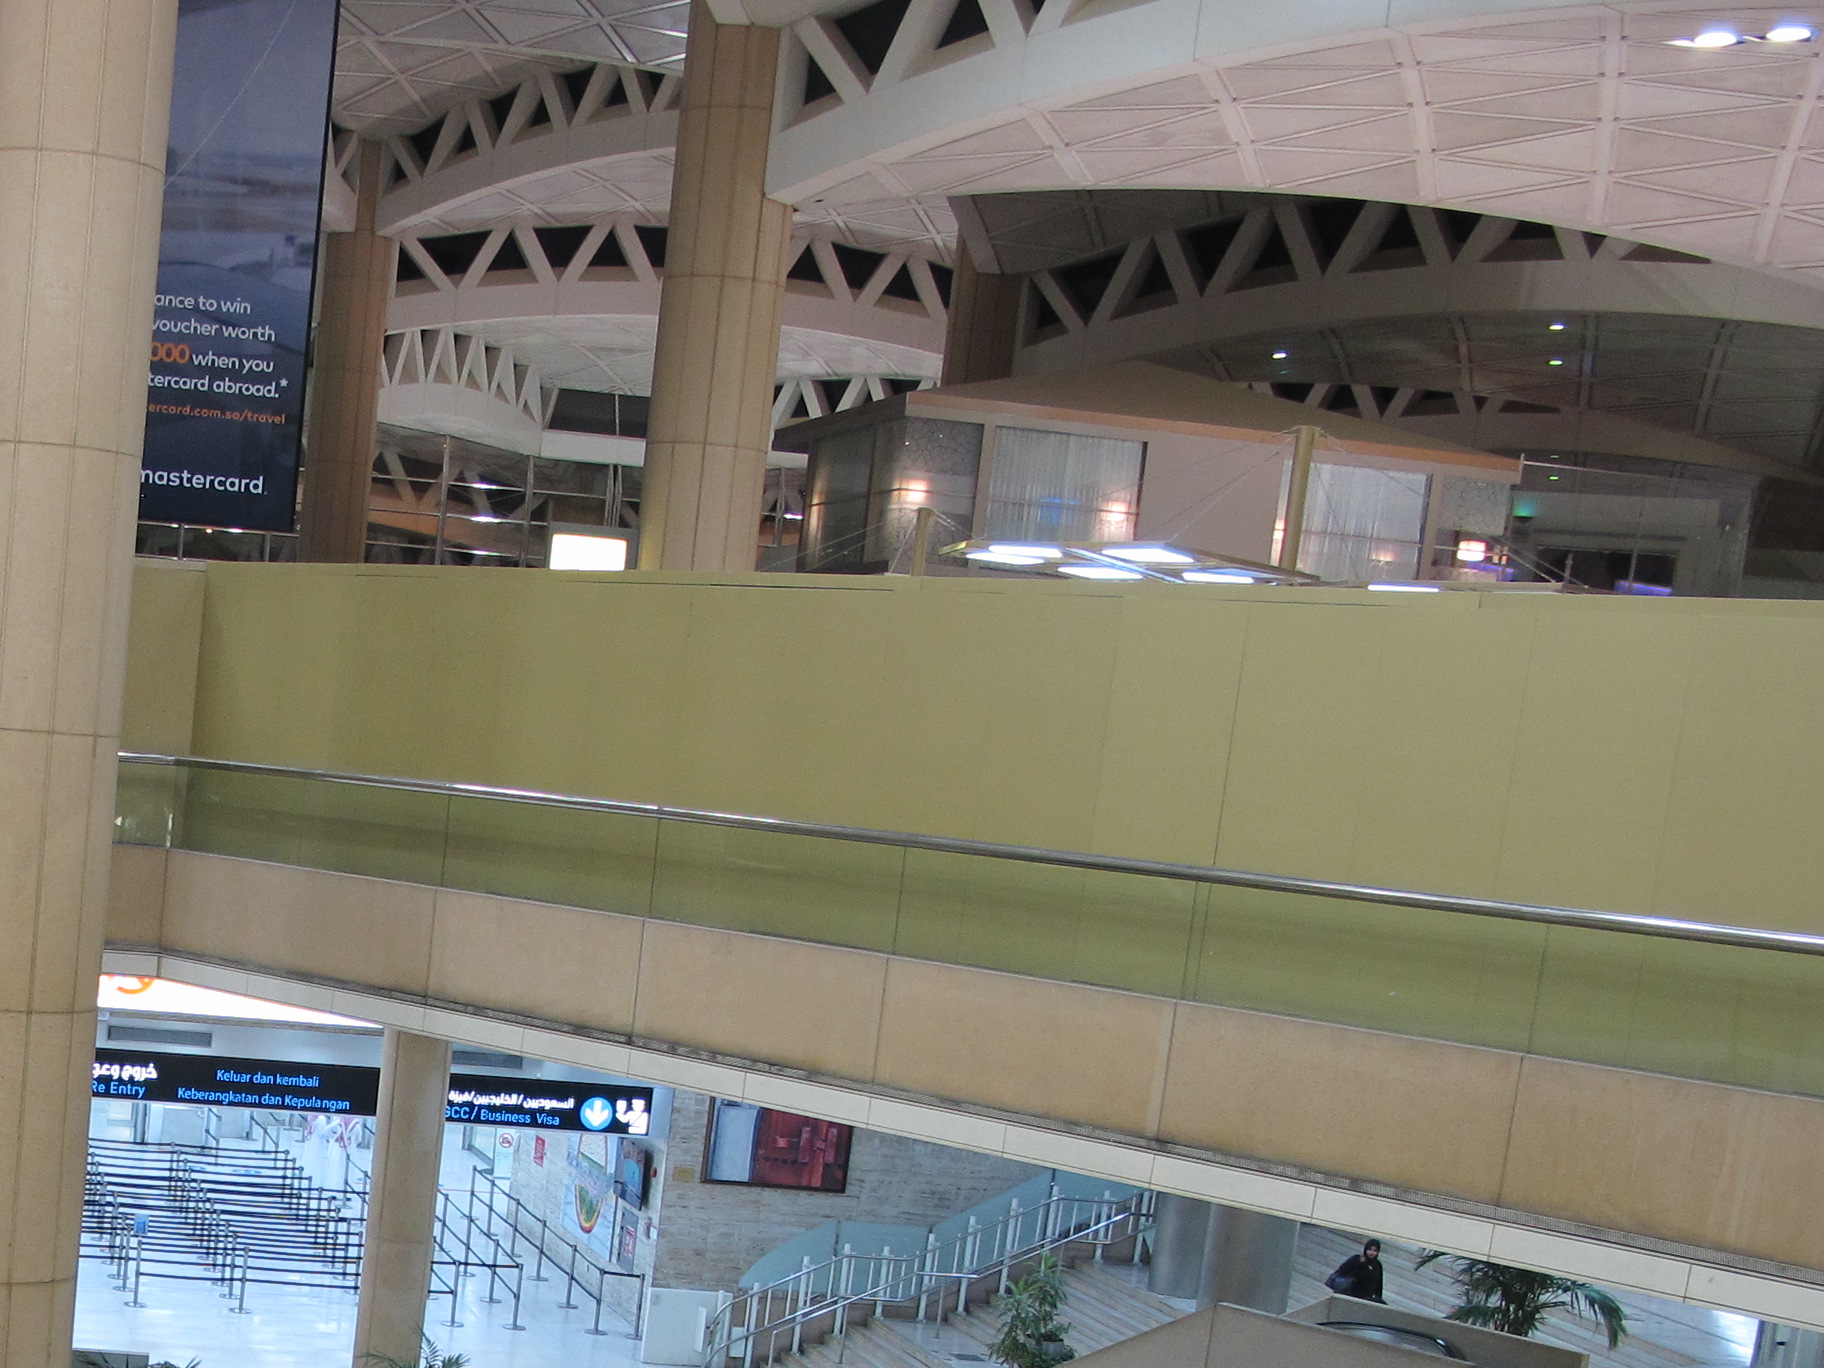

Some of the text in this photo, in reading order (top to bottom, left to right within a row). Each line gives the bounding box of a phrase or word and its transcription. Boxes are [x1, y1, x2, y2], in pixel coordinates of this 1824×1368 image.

[198, 296, 217, 312] to
[220, 298, 251, 315] win
[222, 325, 276, 342] worth
[192, 351, 239, 369] when
[242, 358, 274, 374] you
[216, 1069, 320, 1088] Keluar dan kembali
[110, 1082, 146, 1098] Entry
[177, 1087, 350, 1112] Keberangkatan dan Kepulangan
[480, 1109, 531, 1124] Business
[536, 1112, 560, 1126] Visa
